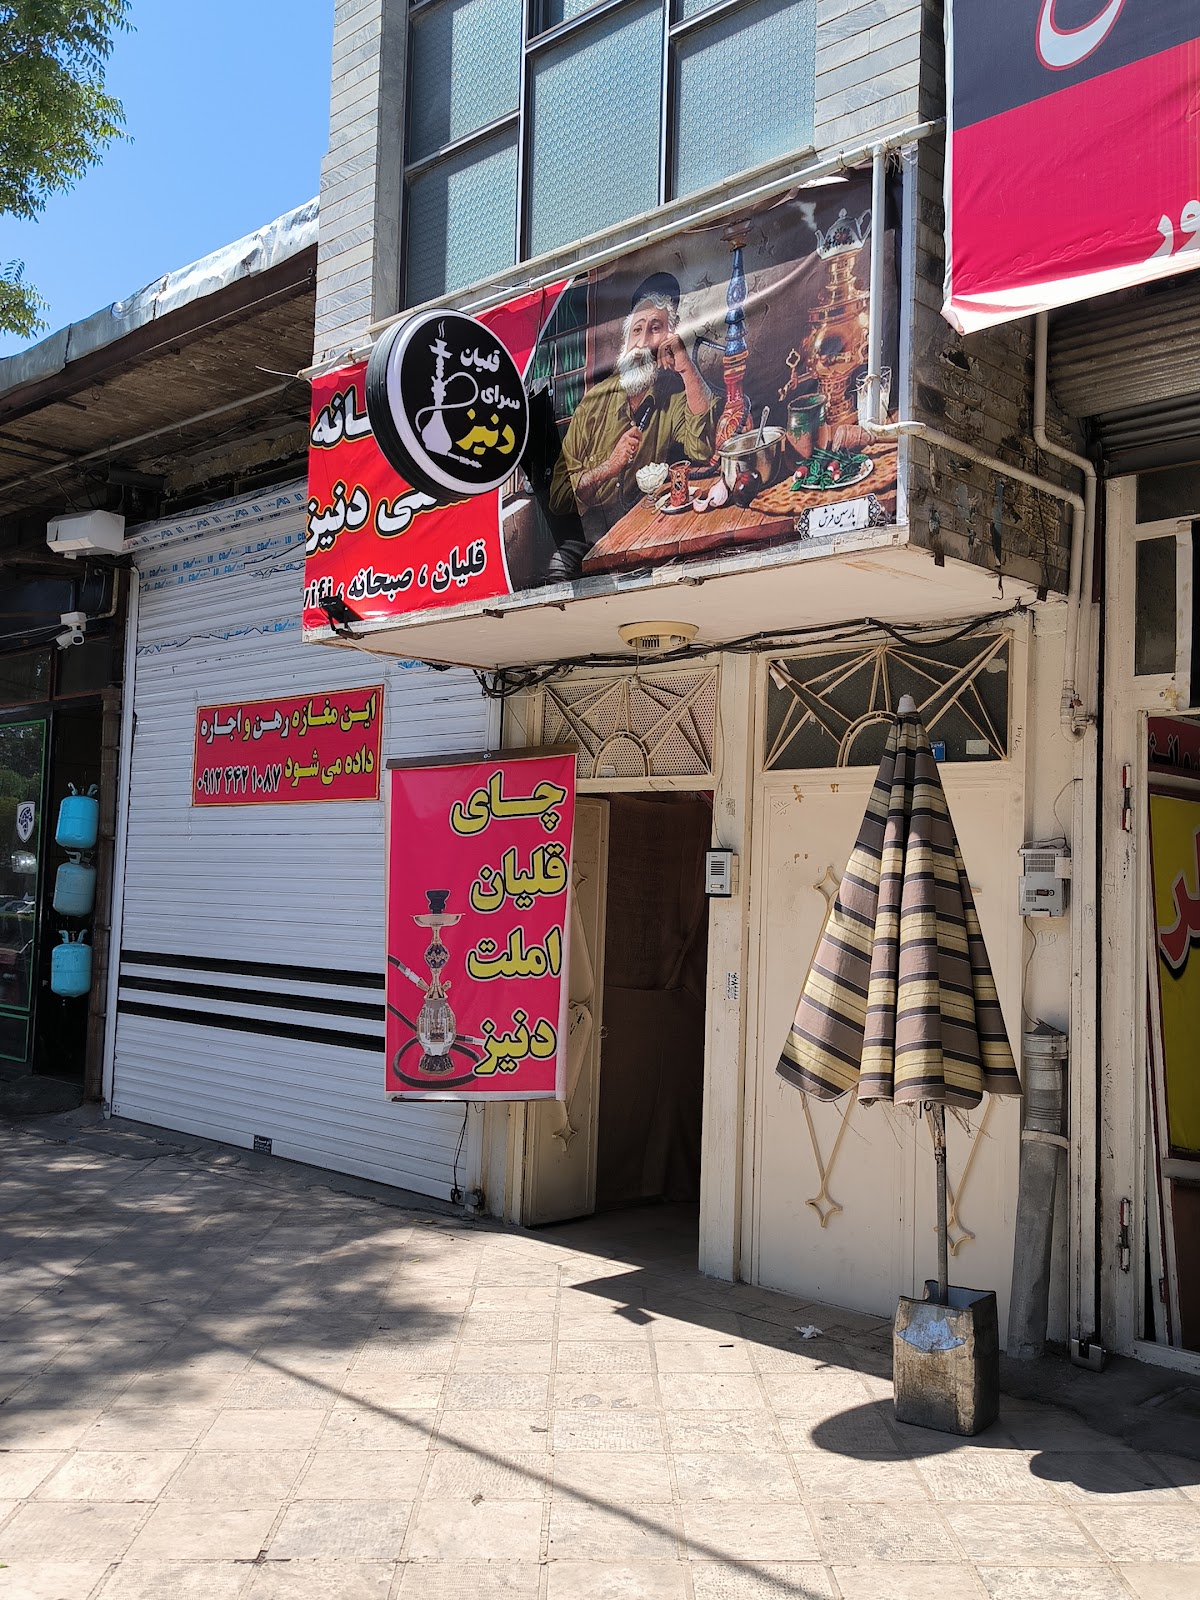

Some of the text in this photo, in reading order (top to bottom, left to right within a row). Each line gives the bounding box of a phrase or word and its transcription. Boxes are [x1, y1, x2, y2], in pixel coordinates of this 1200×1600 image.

[459, 347, 501, 373] قلیان
[310, 384, 374, 449] انه
[480, 384, 521, 411] سرای
[455, 408, 516, 454] دنیز
[306, 480, 370, 557] دنیز
[348, 566, 414, 601] صبحانه
[431, 539, 487, 588] قلیان
[201, 692, 376, 743] این مغازه رهن و اجاره
[344, 744, 374, 774] داده
[450, 770, 566, 835] چای
[470, 842, 568, 912] قلیان
[466, 925, 563, 980] املت
[472, 1008, 558, 1078] دنیز
